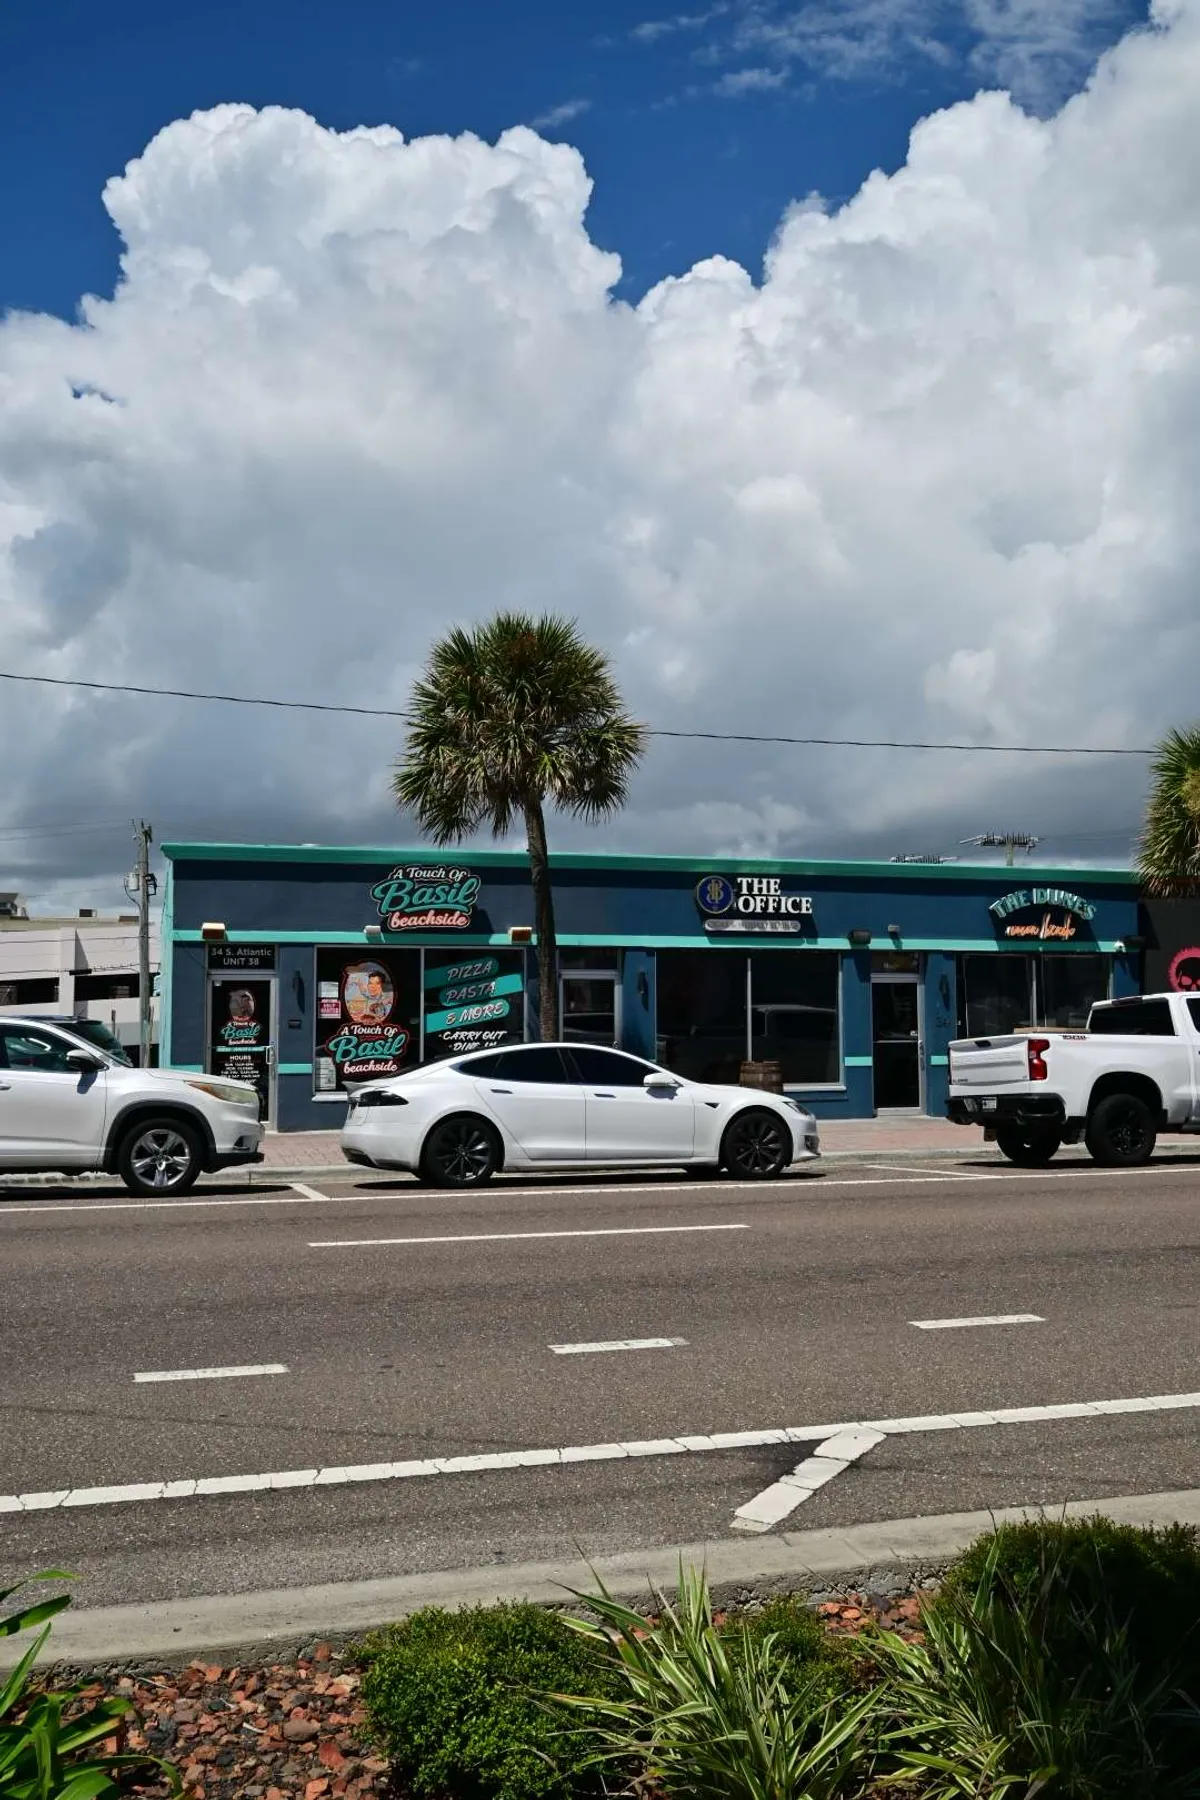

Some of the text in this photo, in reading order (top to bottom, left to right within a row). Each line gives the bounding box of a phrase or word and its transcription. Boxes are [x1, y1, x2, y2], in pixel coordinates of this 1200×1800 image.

[393, 867, 467, 881] A Touch Of
[737, 877, 781, 895] THE
[373, 878, 478, 914] Basil
[738, 895, 813, 914] OFFICE
[988, 889, 1031, 918] THE
[390, 910, 468, 928] beachside
[211, 947, 272, 956] 34 S. Atlantic
[223, 957, 246, 966] UNIT
[447, 960, 493, 981] PIZZA
[445, 981, 496, 1003] PASTA
[459, 1002, 504, 1022] MORE
[220, 1025, 261, 1040] Basil
[341, 1025, 398, 1037] A Touch Of
[442, 1031, 507, 1041] CARRY OUT
[329, 1034, 406, 1063] Basil
[343, 1060, 398, 1074] beachside
